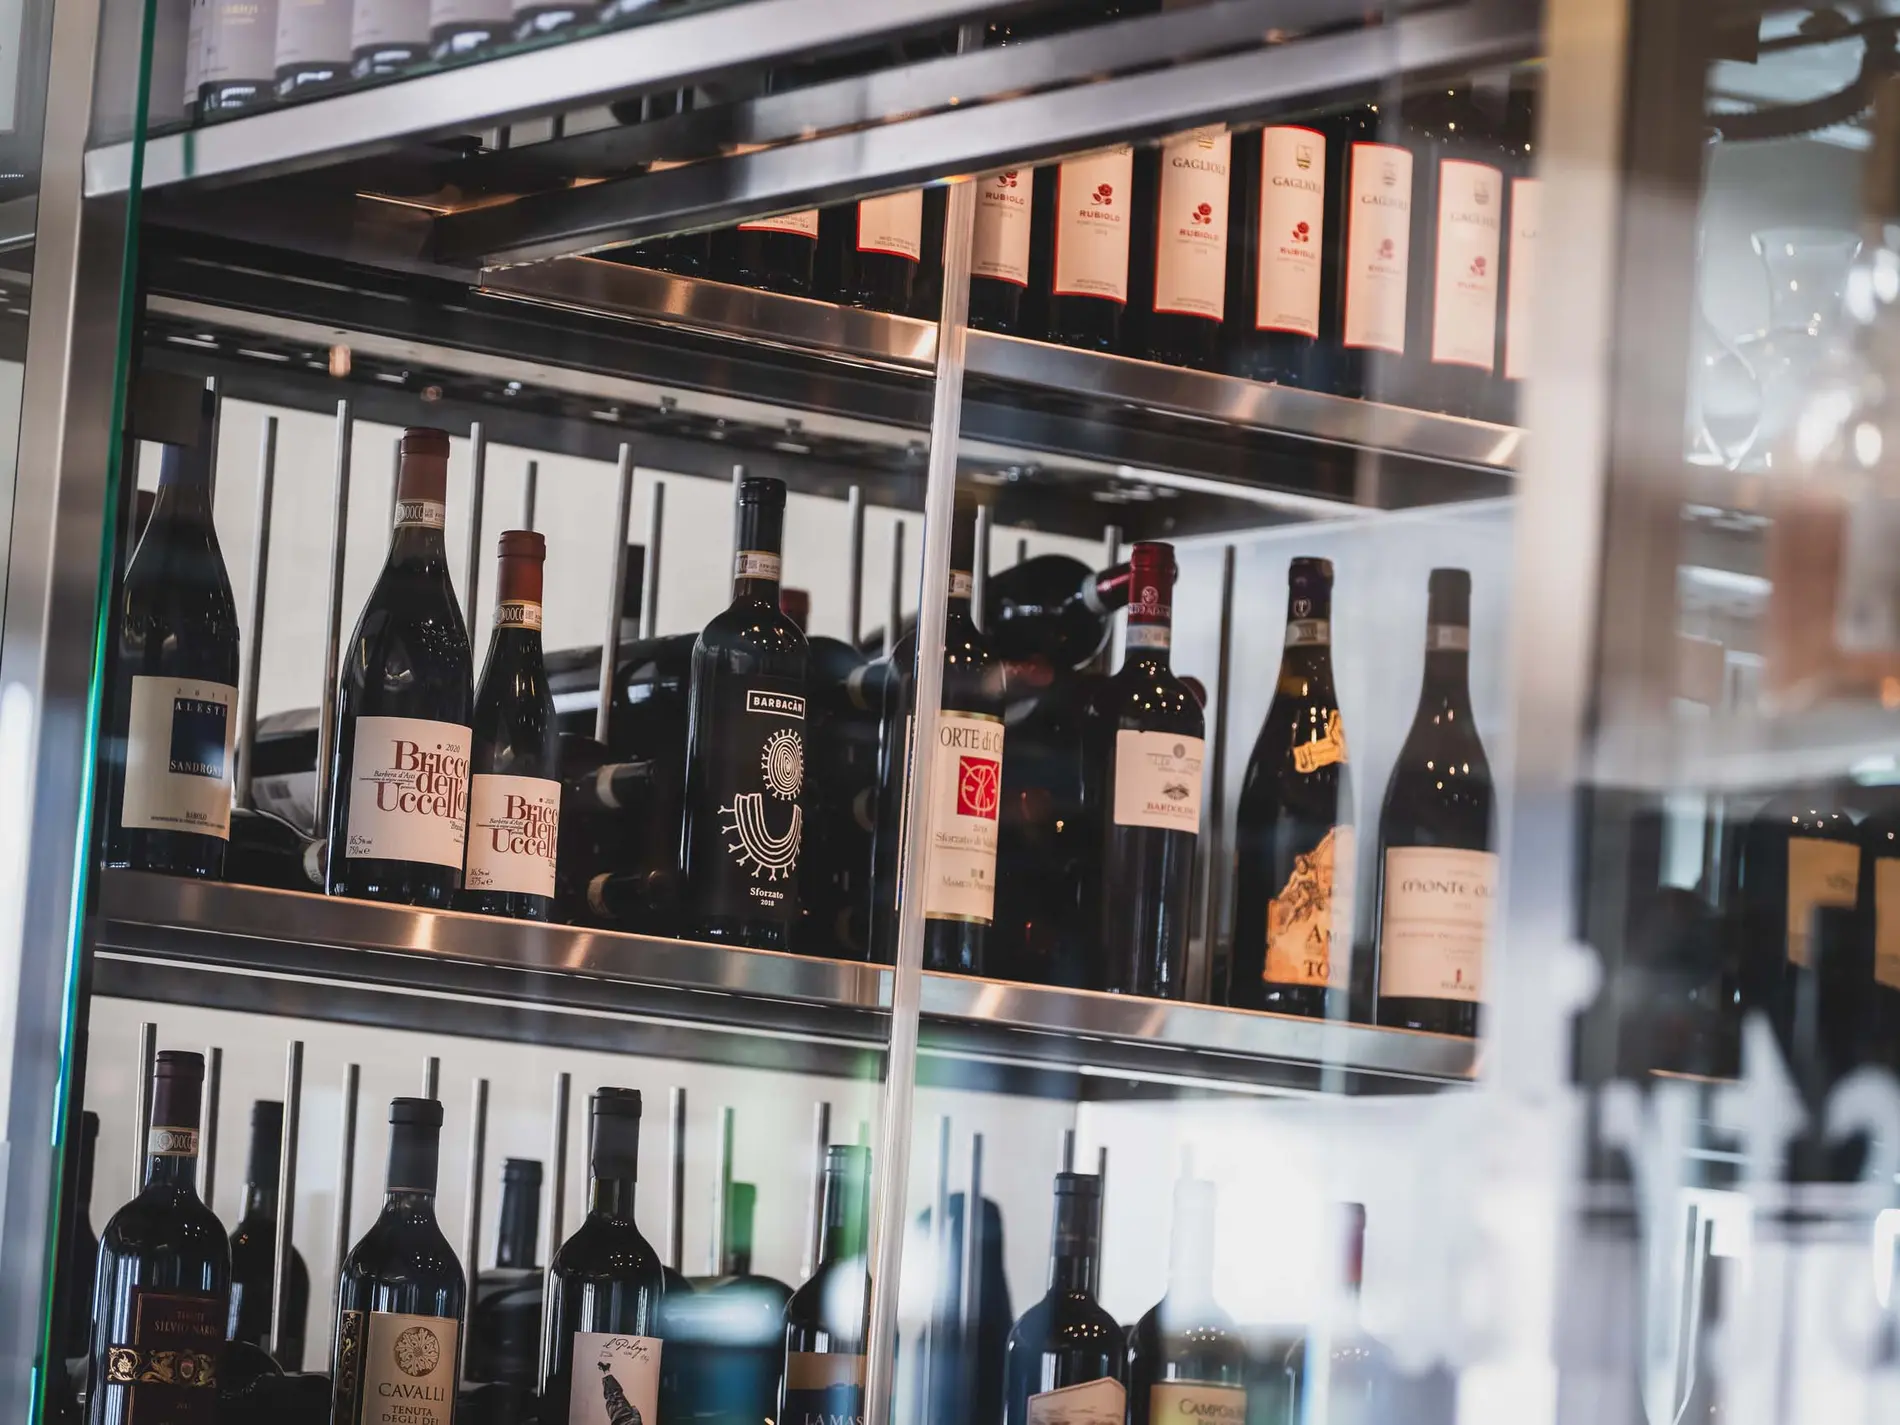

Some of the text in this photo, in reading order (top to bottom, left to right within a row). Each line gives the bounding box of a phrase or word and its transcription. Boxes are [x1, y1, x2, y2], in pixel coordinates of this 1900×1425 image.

[985, 191, 1025, 206] RUBIOLO
[1079, 209, 1120, 222] RUBIOLO
[939, 725, 980, 749] ORTE
[982, 732, 992, 750] di
[374, 780, 468, 820] Uccello
[750, 887, 784, 899] Sforzato
[1401, 879, 1467, 894] MONTE
[154, 1320, 188, 1334] SILVIO
[378, 1382, 445, 1402] CAVALLI
[391, 1405, 433, 1417] TENUTA
[382, 1415, 418, 1424] DEGLI
